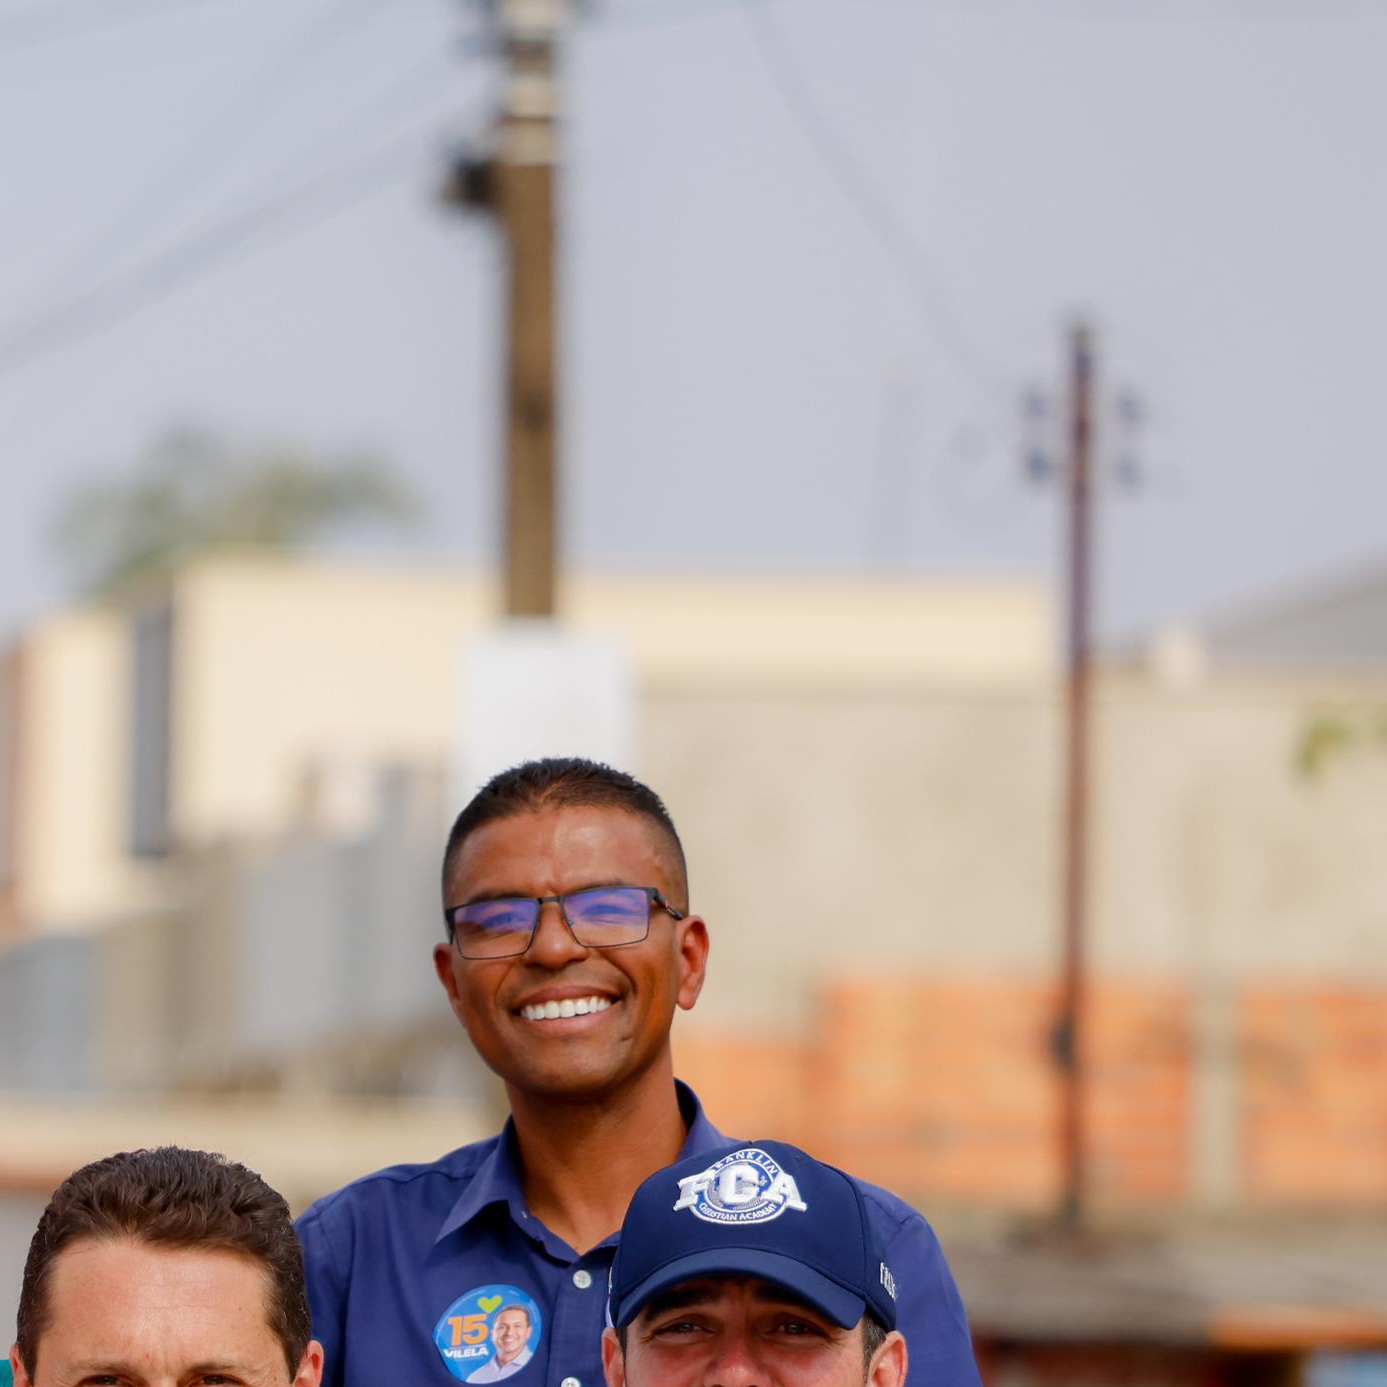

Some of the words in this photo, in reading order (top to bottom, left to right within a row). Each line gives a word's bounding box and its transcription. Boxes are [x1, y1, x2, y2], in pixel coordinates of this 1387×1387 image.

[713, 1150, 779, 1176] RANKLIN
[673, 1162, 808, 1212] FCA
[699, 1202, 738, 1221] CHRISTIAN
[739, 1203, 778, 1221] ACADEMY
[447, 1313, 489, 1346] 15
[443, 1346, 489, 1359] VILELA
